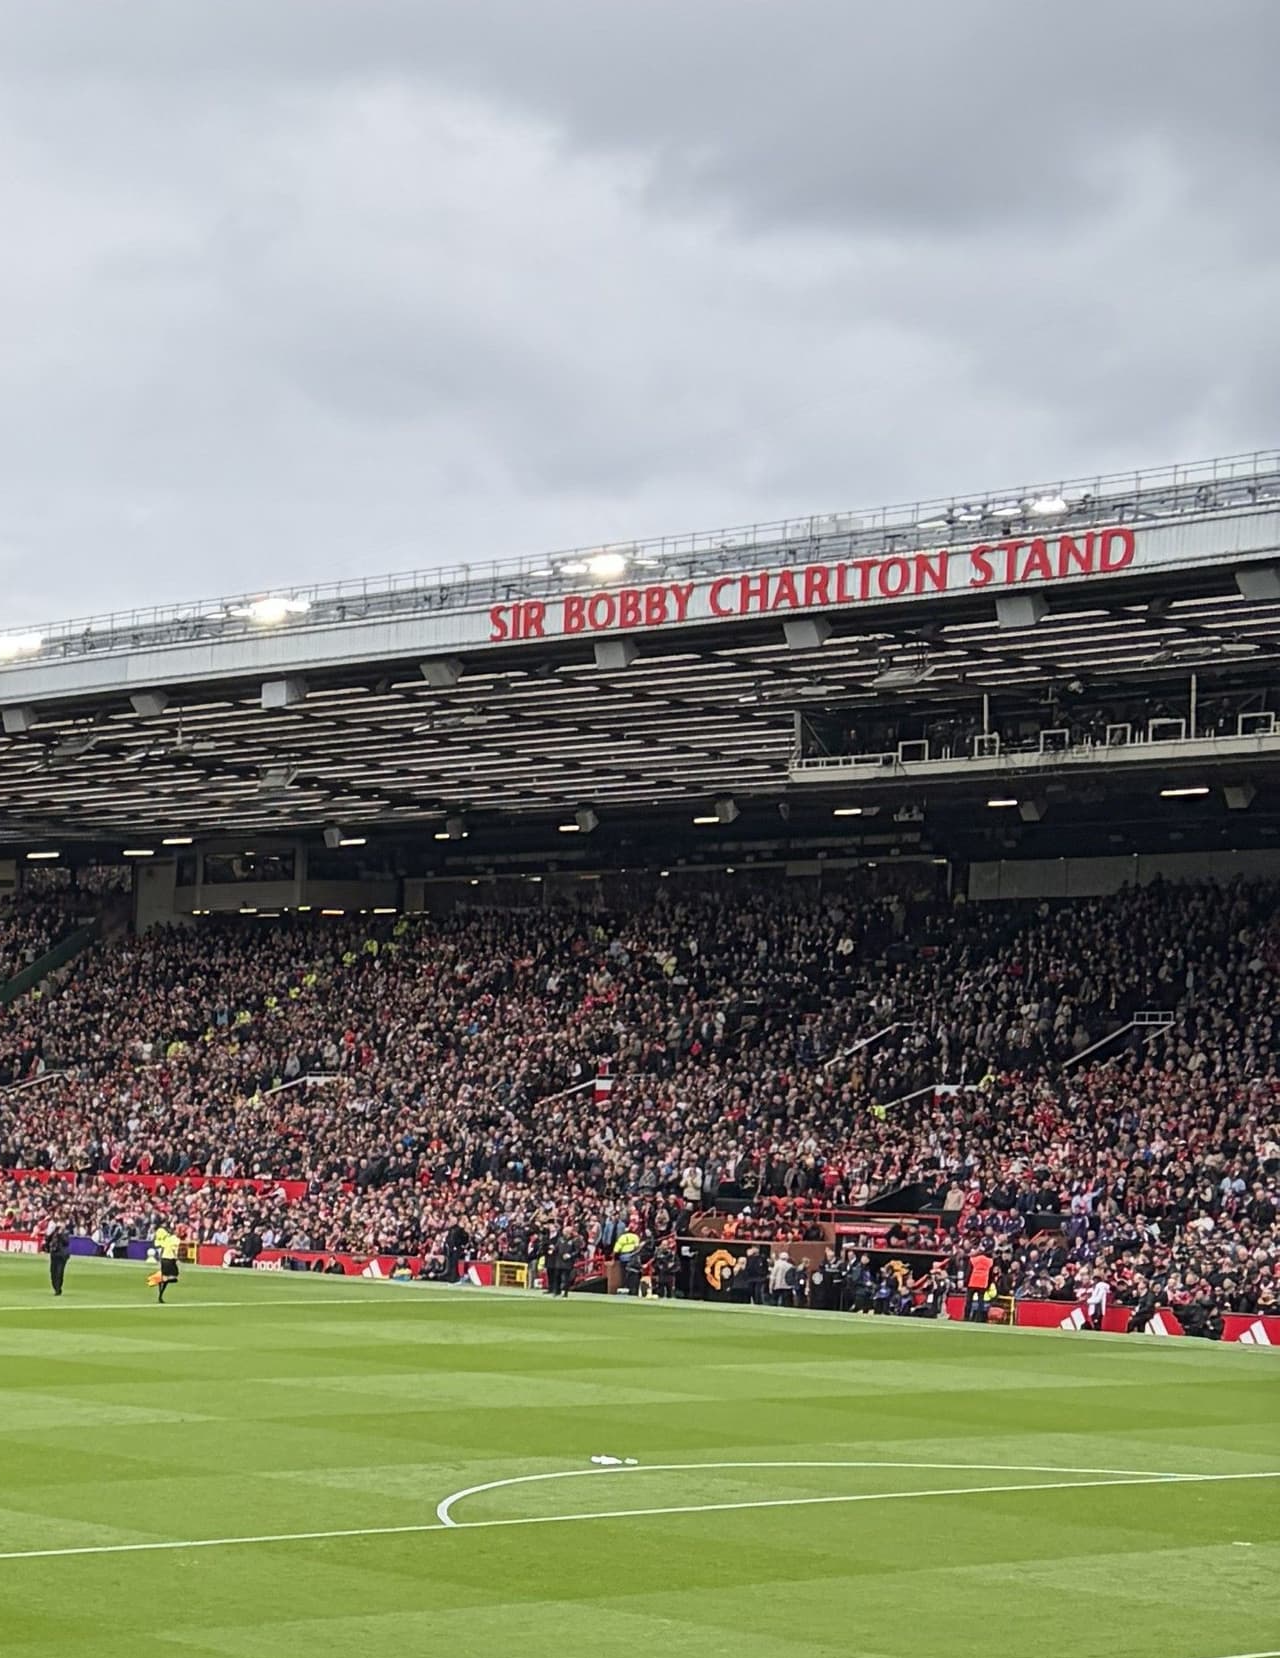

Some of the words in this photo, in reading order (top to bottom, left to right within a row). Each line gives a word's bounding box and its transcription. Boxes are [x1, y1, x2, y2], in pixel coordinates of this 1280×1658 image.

[489, 602, 546, 643] SIR
[562, 583, 694, 634] BOBBY
[708, 550, 949, 617] CHARLTON
[969, 527, 1136, 588] STAND
